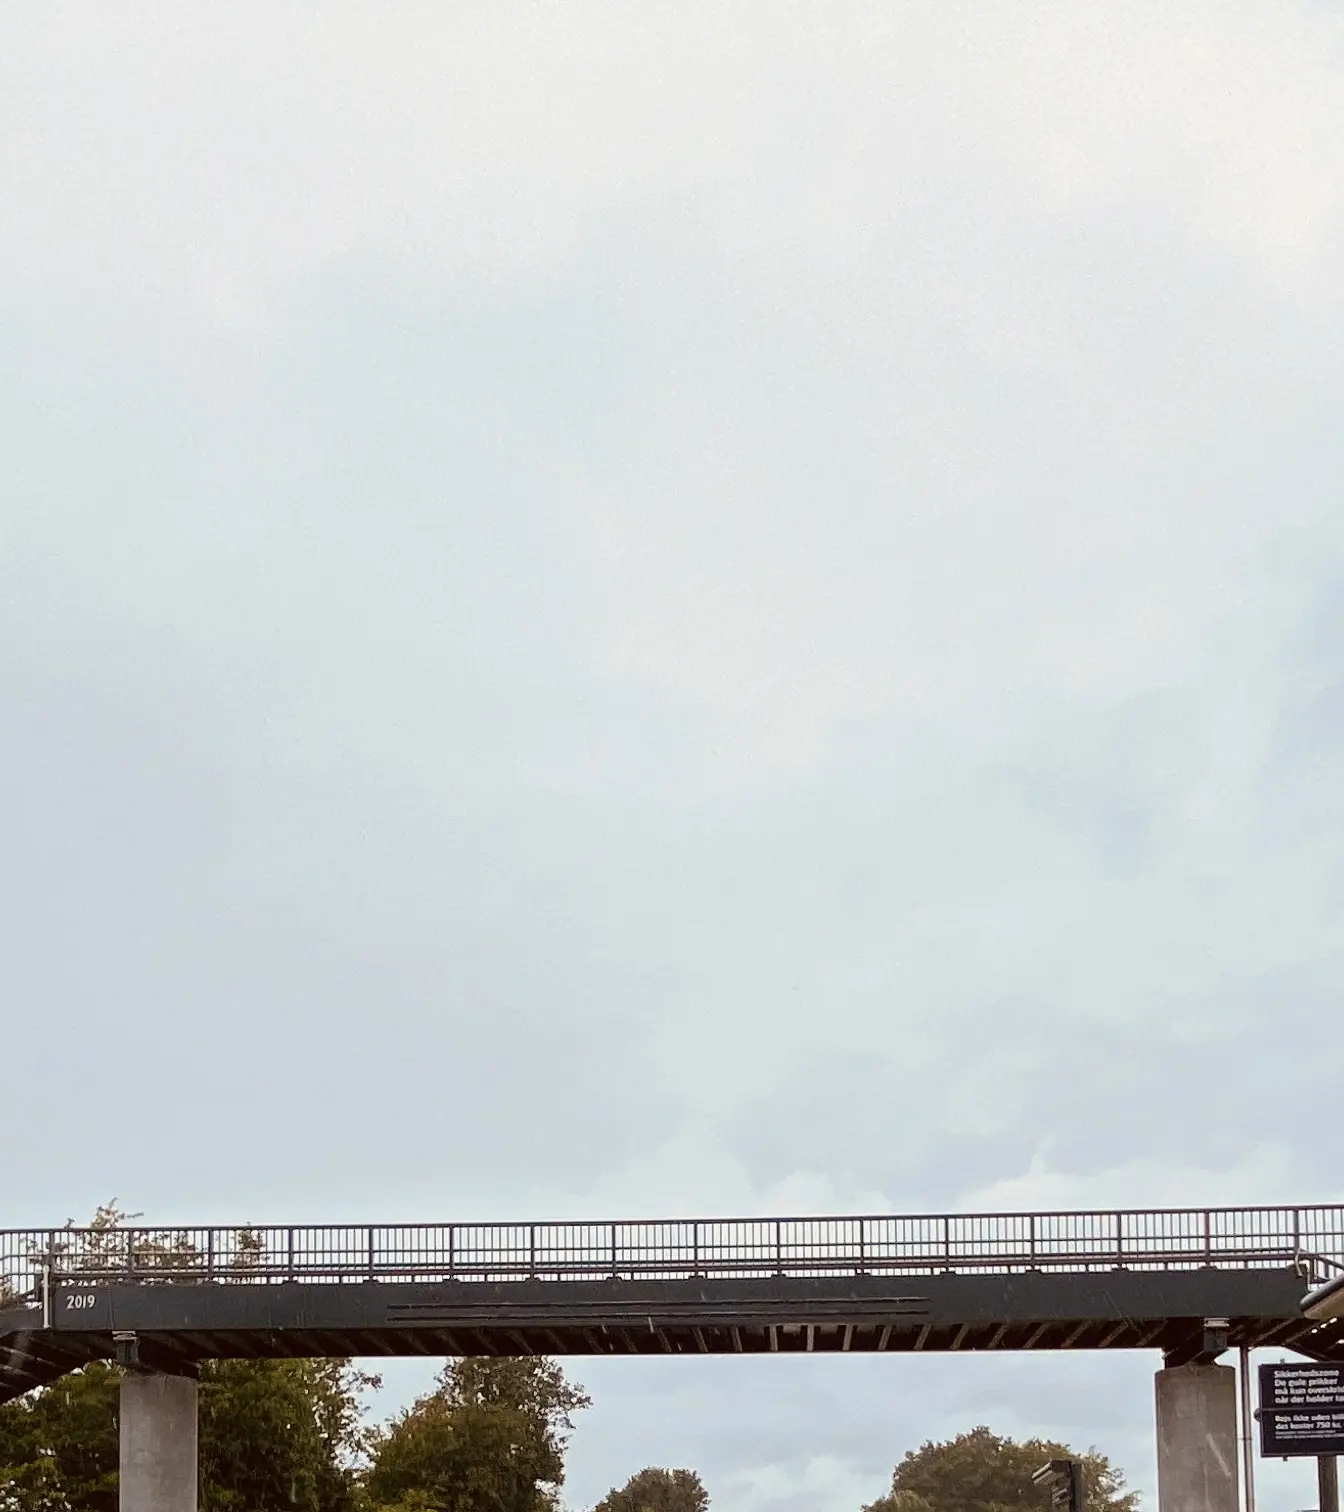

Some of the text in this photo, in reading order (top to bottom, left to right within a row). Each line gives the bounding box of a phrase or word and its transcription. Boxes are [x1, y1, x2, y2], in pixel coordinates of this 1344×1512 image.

[66, 1294, 96, 1309] 2019
[1274, 1370, 1340, 1378] Sikkerhedszone
[1274, 1378, 1338, 1388] De gule prikker
[1306, 1395, 1333, 1403] holder
